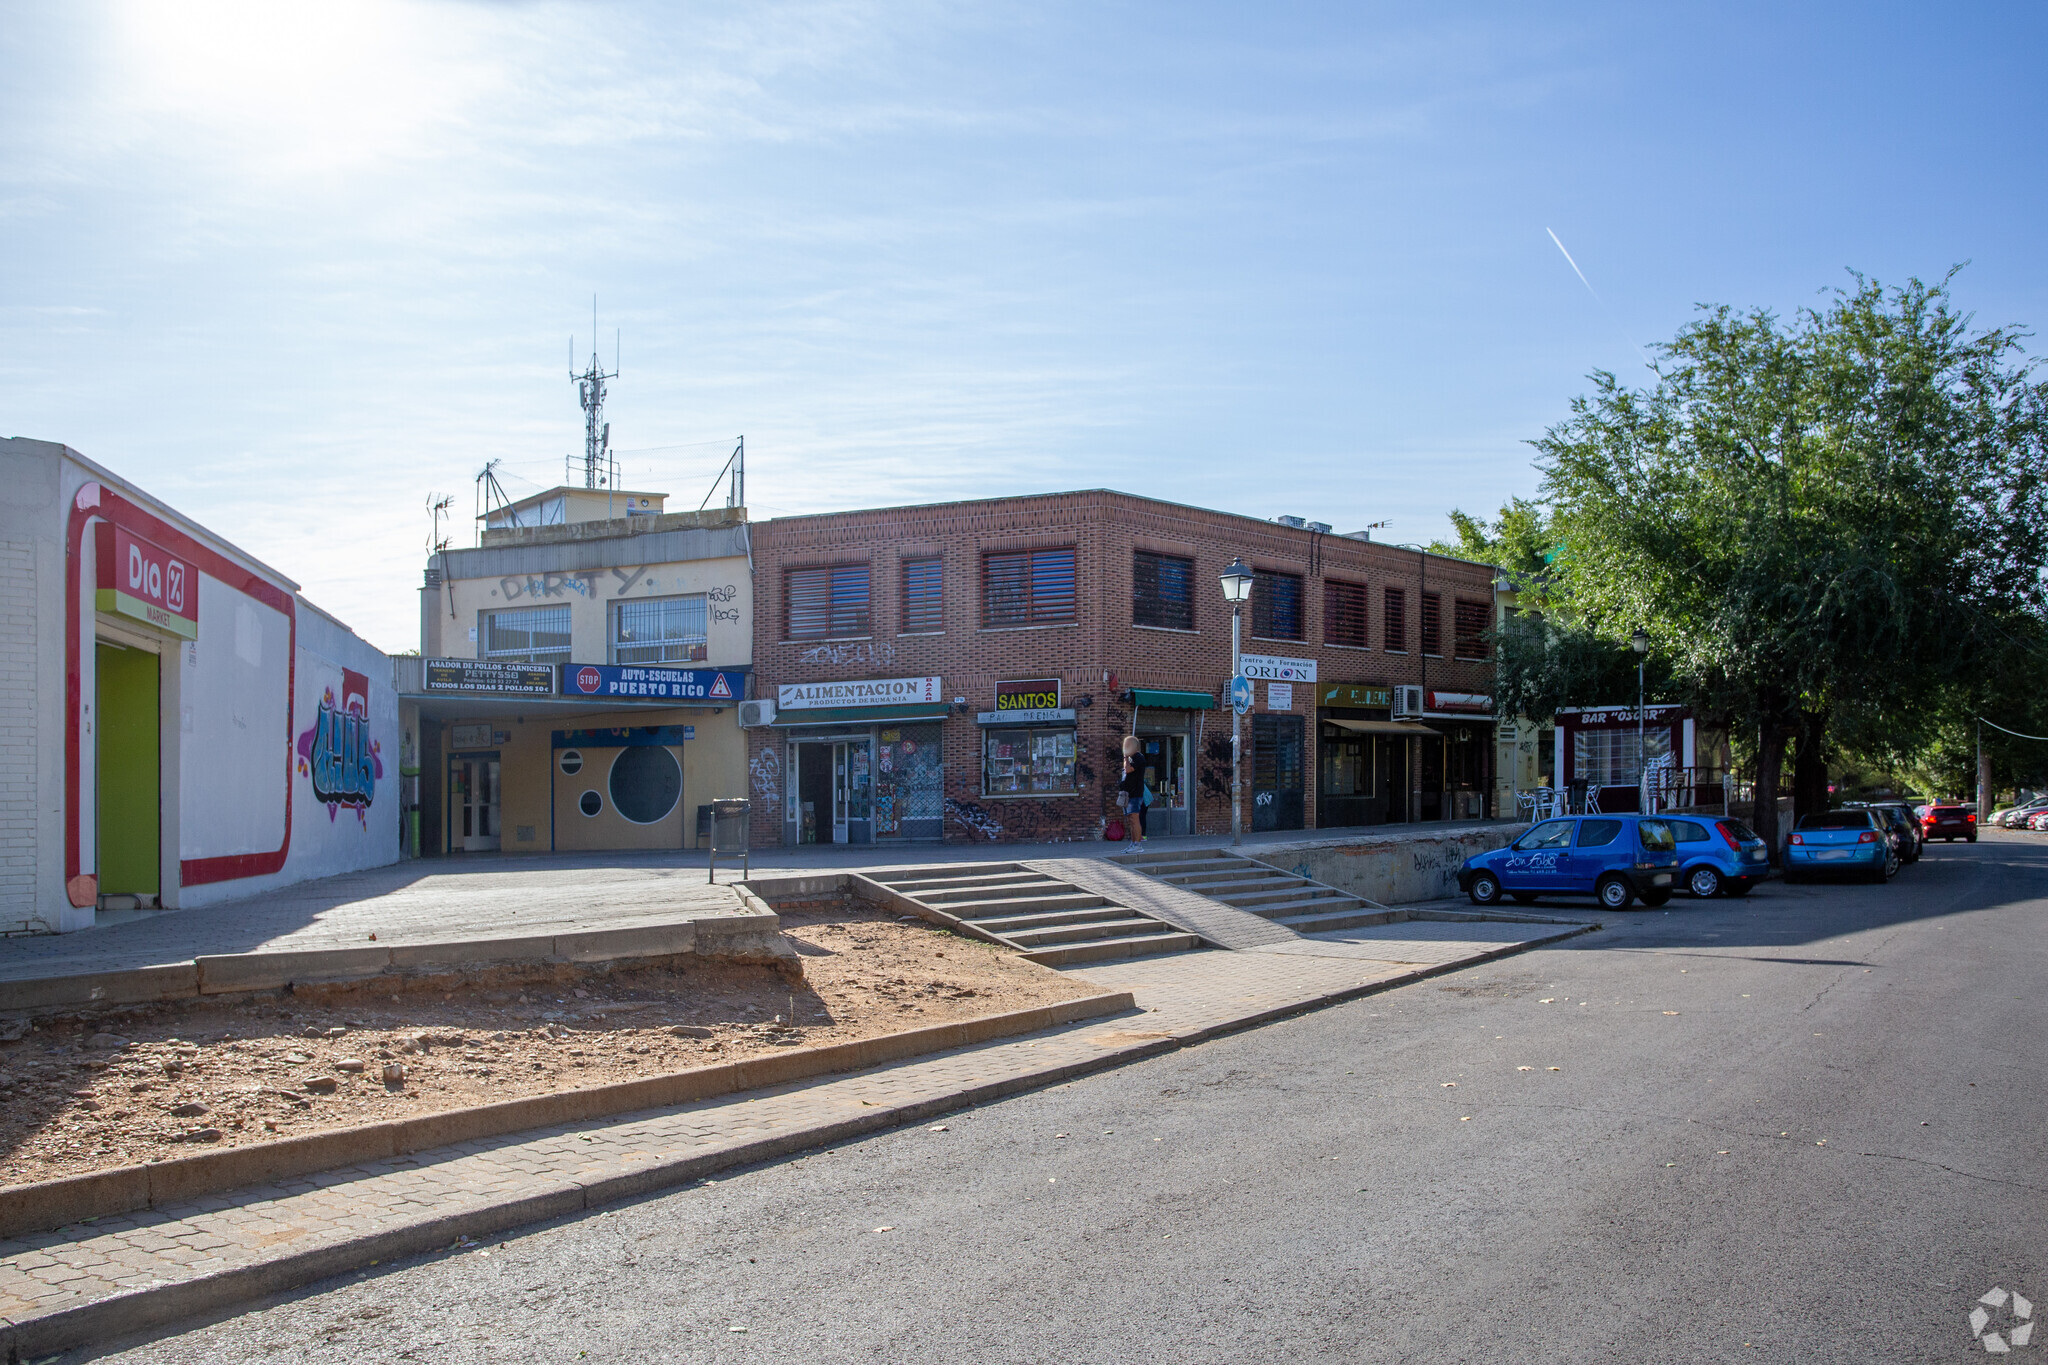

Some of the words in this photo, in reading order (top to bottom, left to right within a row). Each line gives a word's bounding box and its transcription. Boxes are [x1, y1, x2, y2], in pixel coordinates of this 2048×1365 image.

[500, 566, 648, 601] DIRTY
[146, 605, 171, 628] MARKET
[429, 661, 462, 669] ASADOR
[474, 663, 502, 671] POLLOS
[507, 664, 551, 673] CARNICERIA
[1240, 656, 1263, 664] Centro
[1279, 659, 1313, 668] Formación
[579, 674, 599, 685] STOP
[621, 668, 694, 683] AUTO-ESCUELAS
[460, 682, 475, 690] LOS
[609, 681, 666, 695] PUERTO
[672, 684, 705, 697] RICO
[794, 682, 918, 700] ALIMENTACION
[925, 678, 933, 701] BAZAR
[998, 692, 1056, 710] SANTOS
[1581, 712, 1607, 724] BAR
[1505, 852, 1526, 867] don
